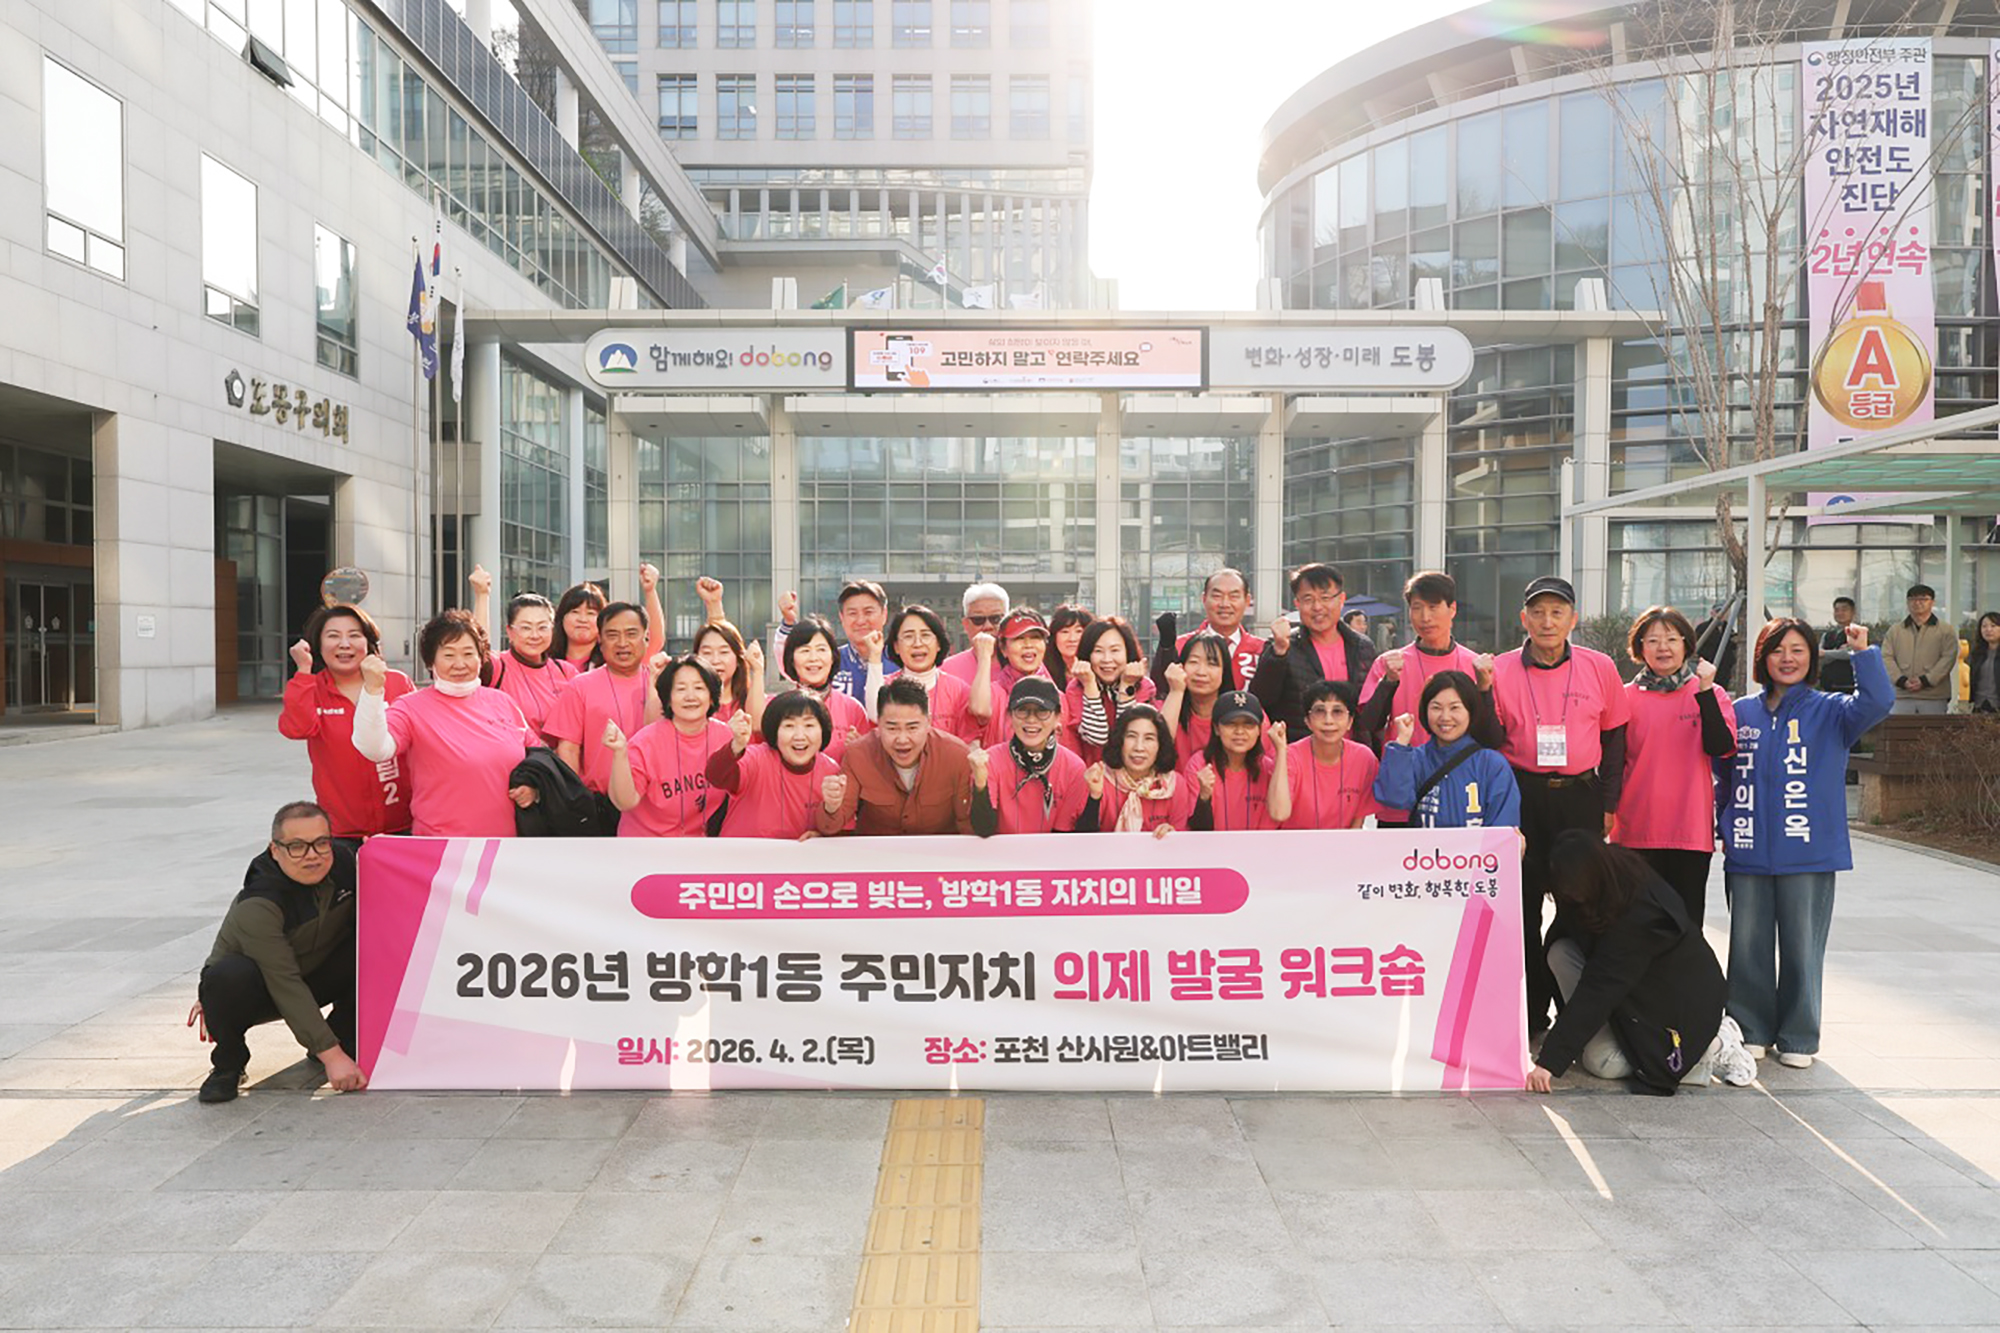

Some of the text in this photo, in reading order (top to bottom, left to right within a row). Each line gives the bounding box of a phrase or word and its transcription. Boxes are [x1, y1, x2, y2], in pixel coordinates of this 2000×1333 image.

[1826, 47, 1926, 66] 행정안전부 주관
[1816, 72, 1920, 101] 2025년
[1809, 108, 1926, 140] 자연재해
[1825, 145, 1913, 176] 안전도
[1841, 182, 1900, 213] 진단
[739, 345, 832, 371] dobong
[909, 346, 926, 355] 109
[940, 351, 1140, 367] 고민하지 말고 연락주세요
[1390, 344, 1436, 372] 도봉
[1846, 328, 1898, 388] A
[1850, 392, 1893, 417] 등급
[383, 782, 399, 805] 2
[1783, 719, 1811, 843] 1 신은옥
[1465, 782, 1482, 813] 1
[1402, 848, 1499, 874] dobong
[679, 876, 1202, 910] 주민의 손으로 빚는, 방학1동 자치의 내일
[1357, 883, 1384, 899] 같이
[1425, 879, 1469, 898] 행복한
[1474, 878, 1499, 898] 도봉
[456, 943, 1426, 1002] 2026년 방학1동 주민자치 의제 발굴 워크숍
[616, 1036, 680, 1066] 일시:
[686, 1037, 763, 1064] 2026.
[769, 1037, 795, 1064] 4.
[924, 1033, 1269, 1064] 장소: 포천 산사원&아트밸리
